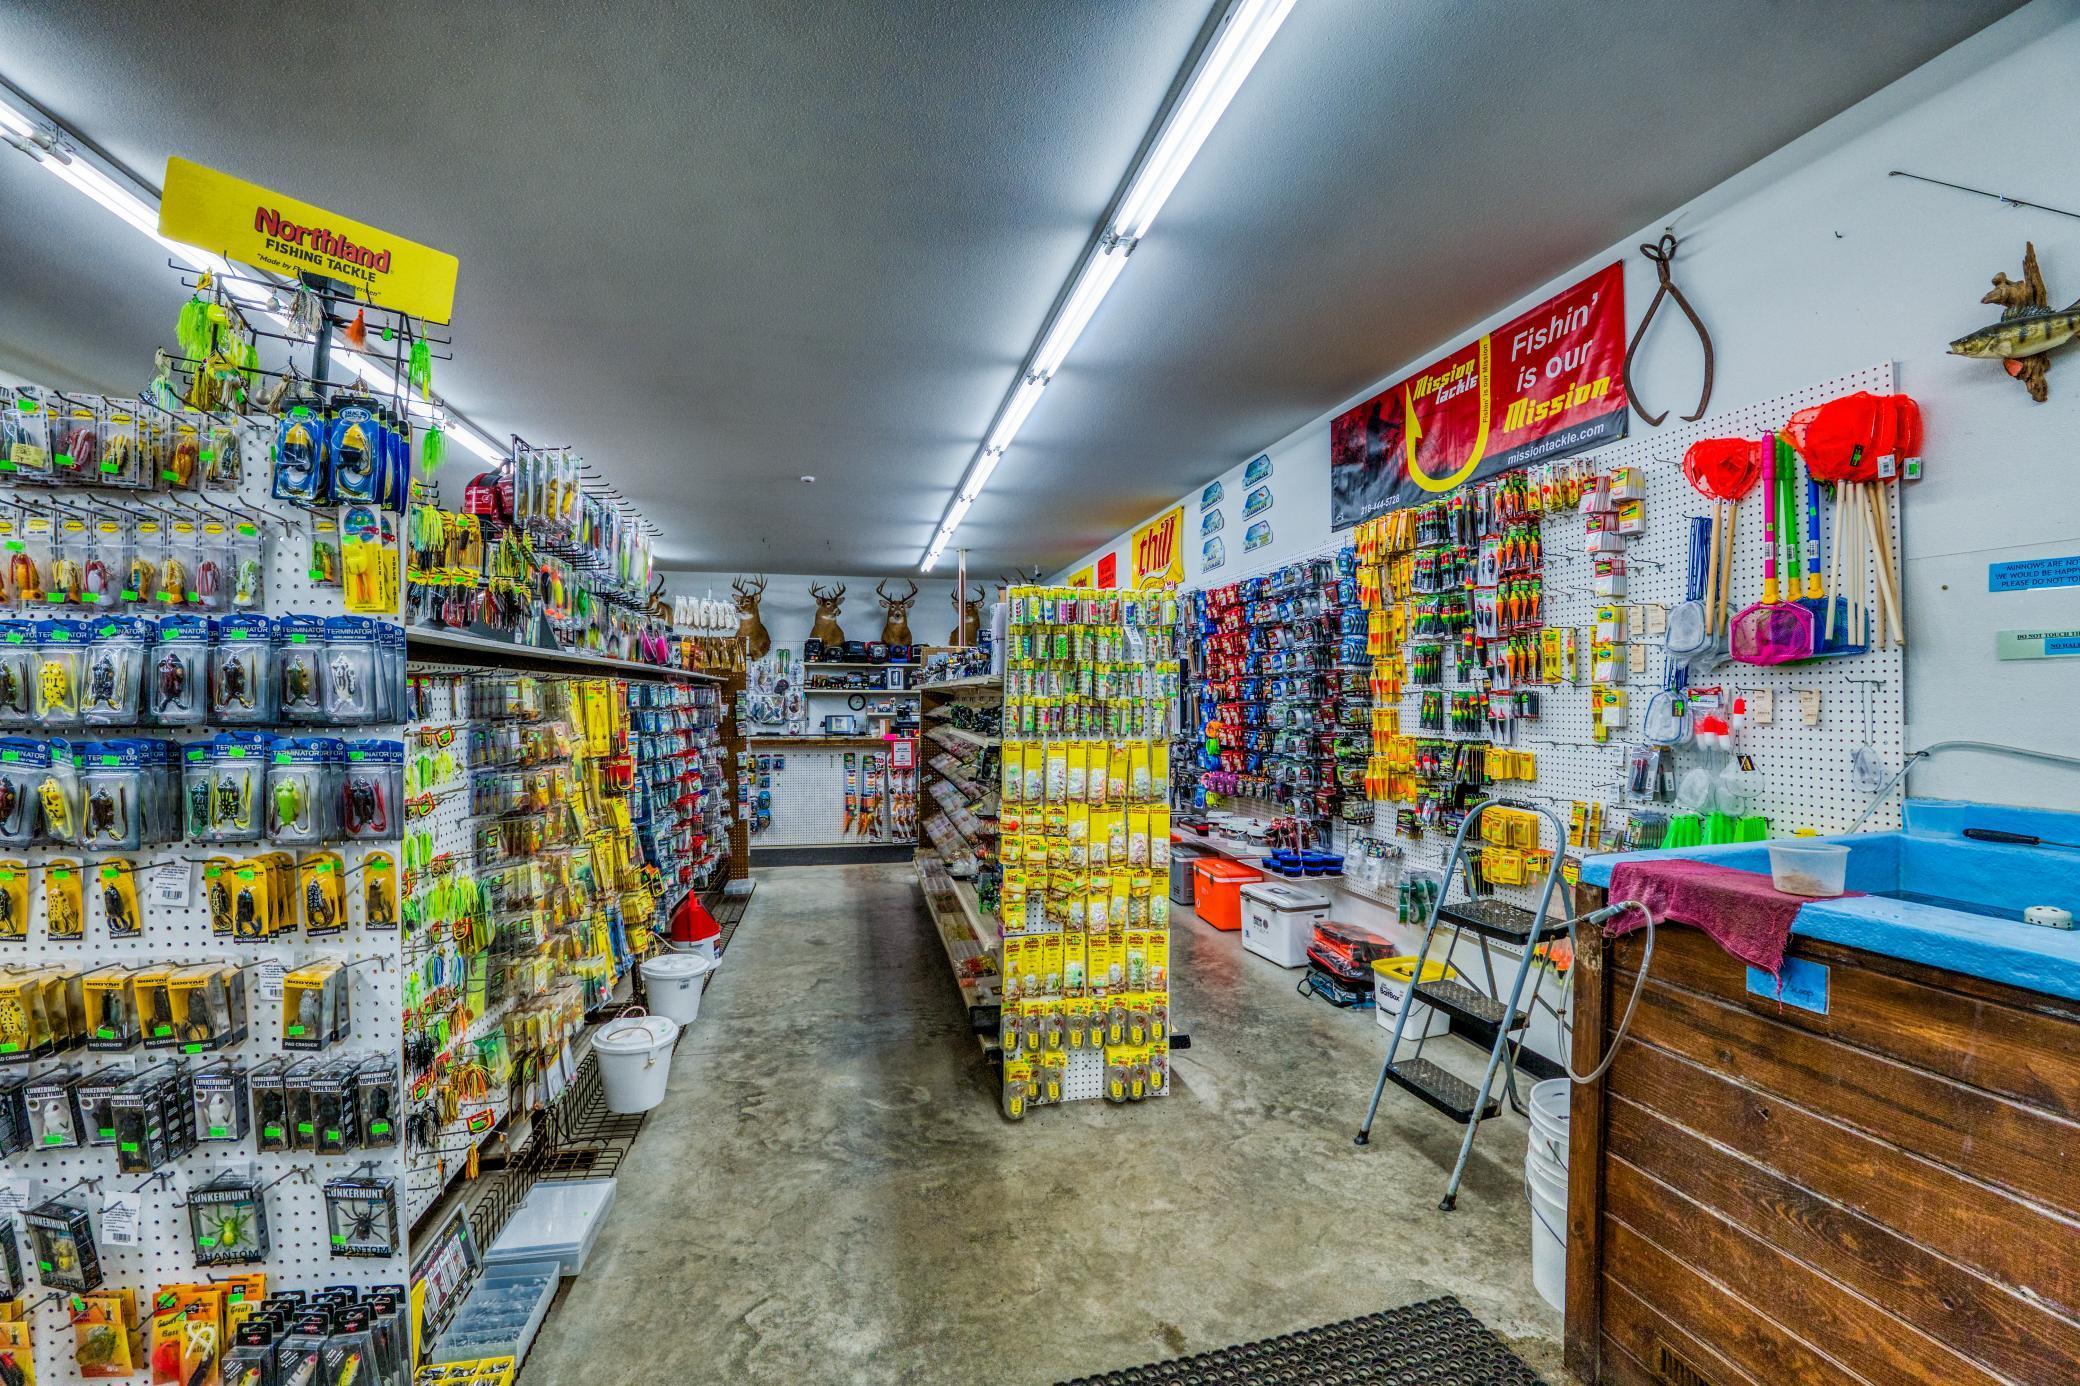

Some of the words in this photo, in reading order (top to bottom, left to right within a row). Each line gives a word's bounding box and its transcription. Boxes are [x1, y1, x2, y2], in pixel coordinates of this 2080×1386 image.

[254, 206, 391, 274] Northland
[266, 238, 322, 266] FISHING
[327, 258, 376, 283] TACKLE
[282, 262, 291, 270] by
[1516, 366, 1537, 392] is
[1545, 340, 1592, 378] our
[1413, 358, 1476, 401] Mission
[1435, 372, 1479, 405] Tackle
[1504, 376, 1611, 434] Mission
[1507, 424, 1604, 465] missiontackle.com
[1360, 494, 1400, 516] 218-444-5728
[1139, 516, 1176, 576] thill
[2006, 562, 2045, 572] MINNOWS
[2010, 570, 2039, 578] WOULD
[1380, 986, 1400, 1002] BaitBox
[190, 1190, 250, 1203] LUNKERHUNT
[327, 1188, 384, 1198] LUNKERHUNT
[26, 1215, 68, 1232] LUNKERHUNT
[196, 1250, 260, 1262] PHANTOM
[332, 1244, 389, 1254] PHANTOM
[184, 1322, 201, 1331] Geat
